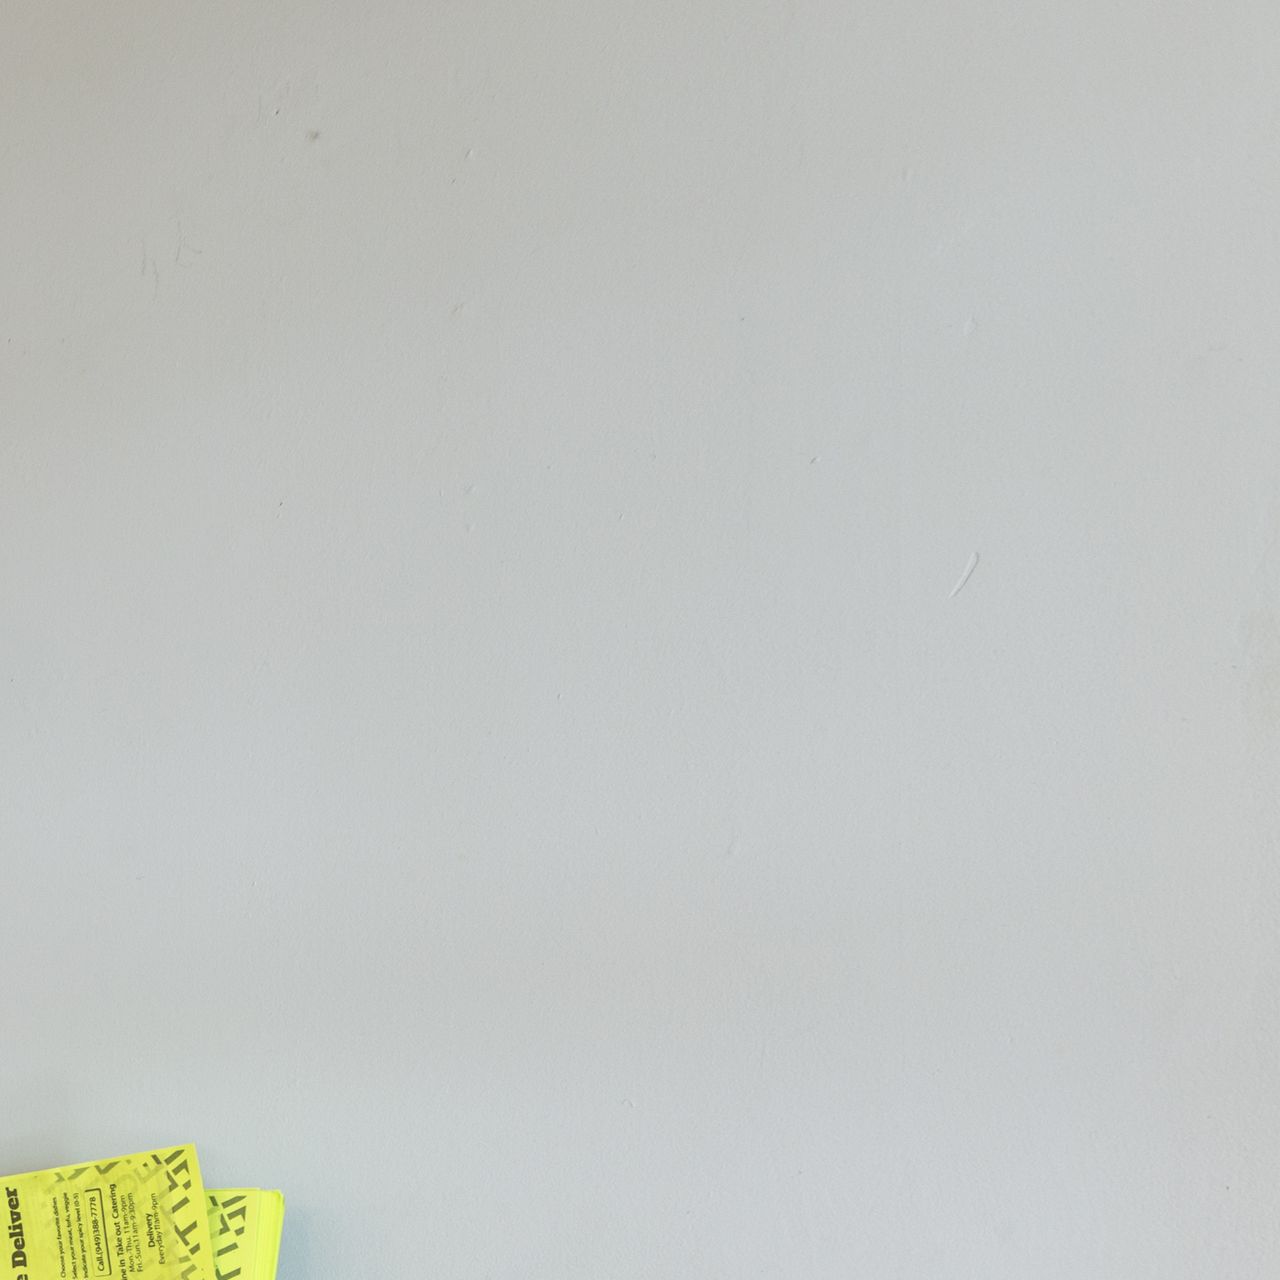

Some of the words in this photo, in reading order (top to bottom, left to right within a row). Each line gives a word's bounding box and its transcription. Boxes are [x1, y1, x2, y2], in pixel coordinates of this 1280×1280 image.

[109, 1184, 118, 1218] Catering
[5, 1187, 27, 1268] Deliver
[146, 1213, 155, 1247] Delivery
[116, 1237, 124, 1256] Take
[119, 1259, 125, 1267] in
